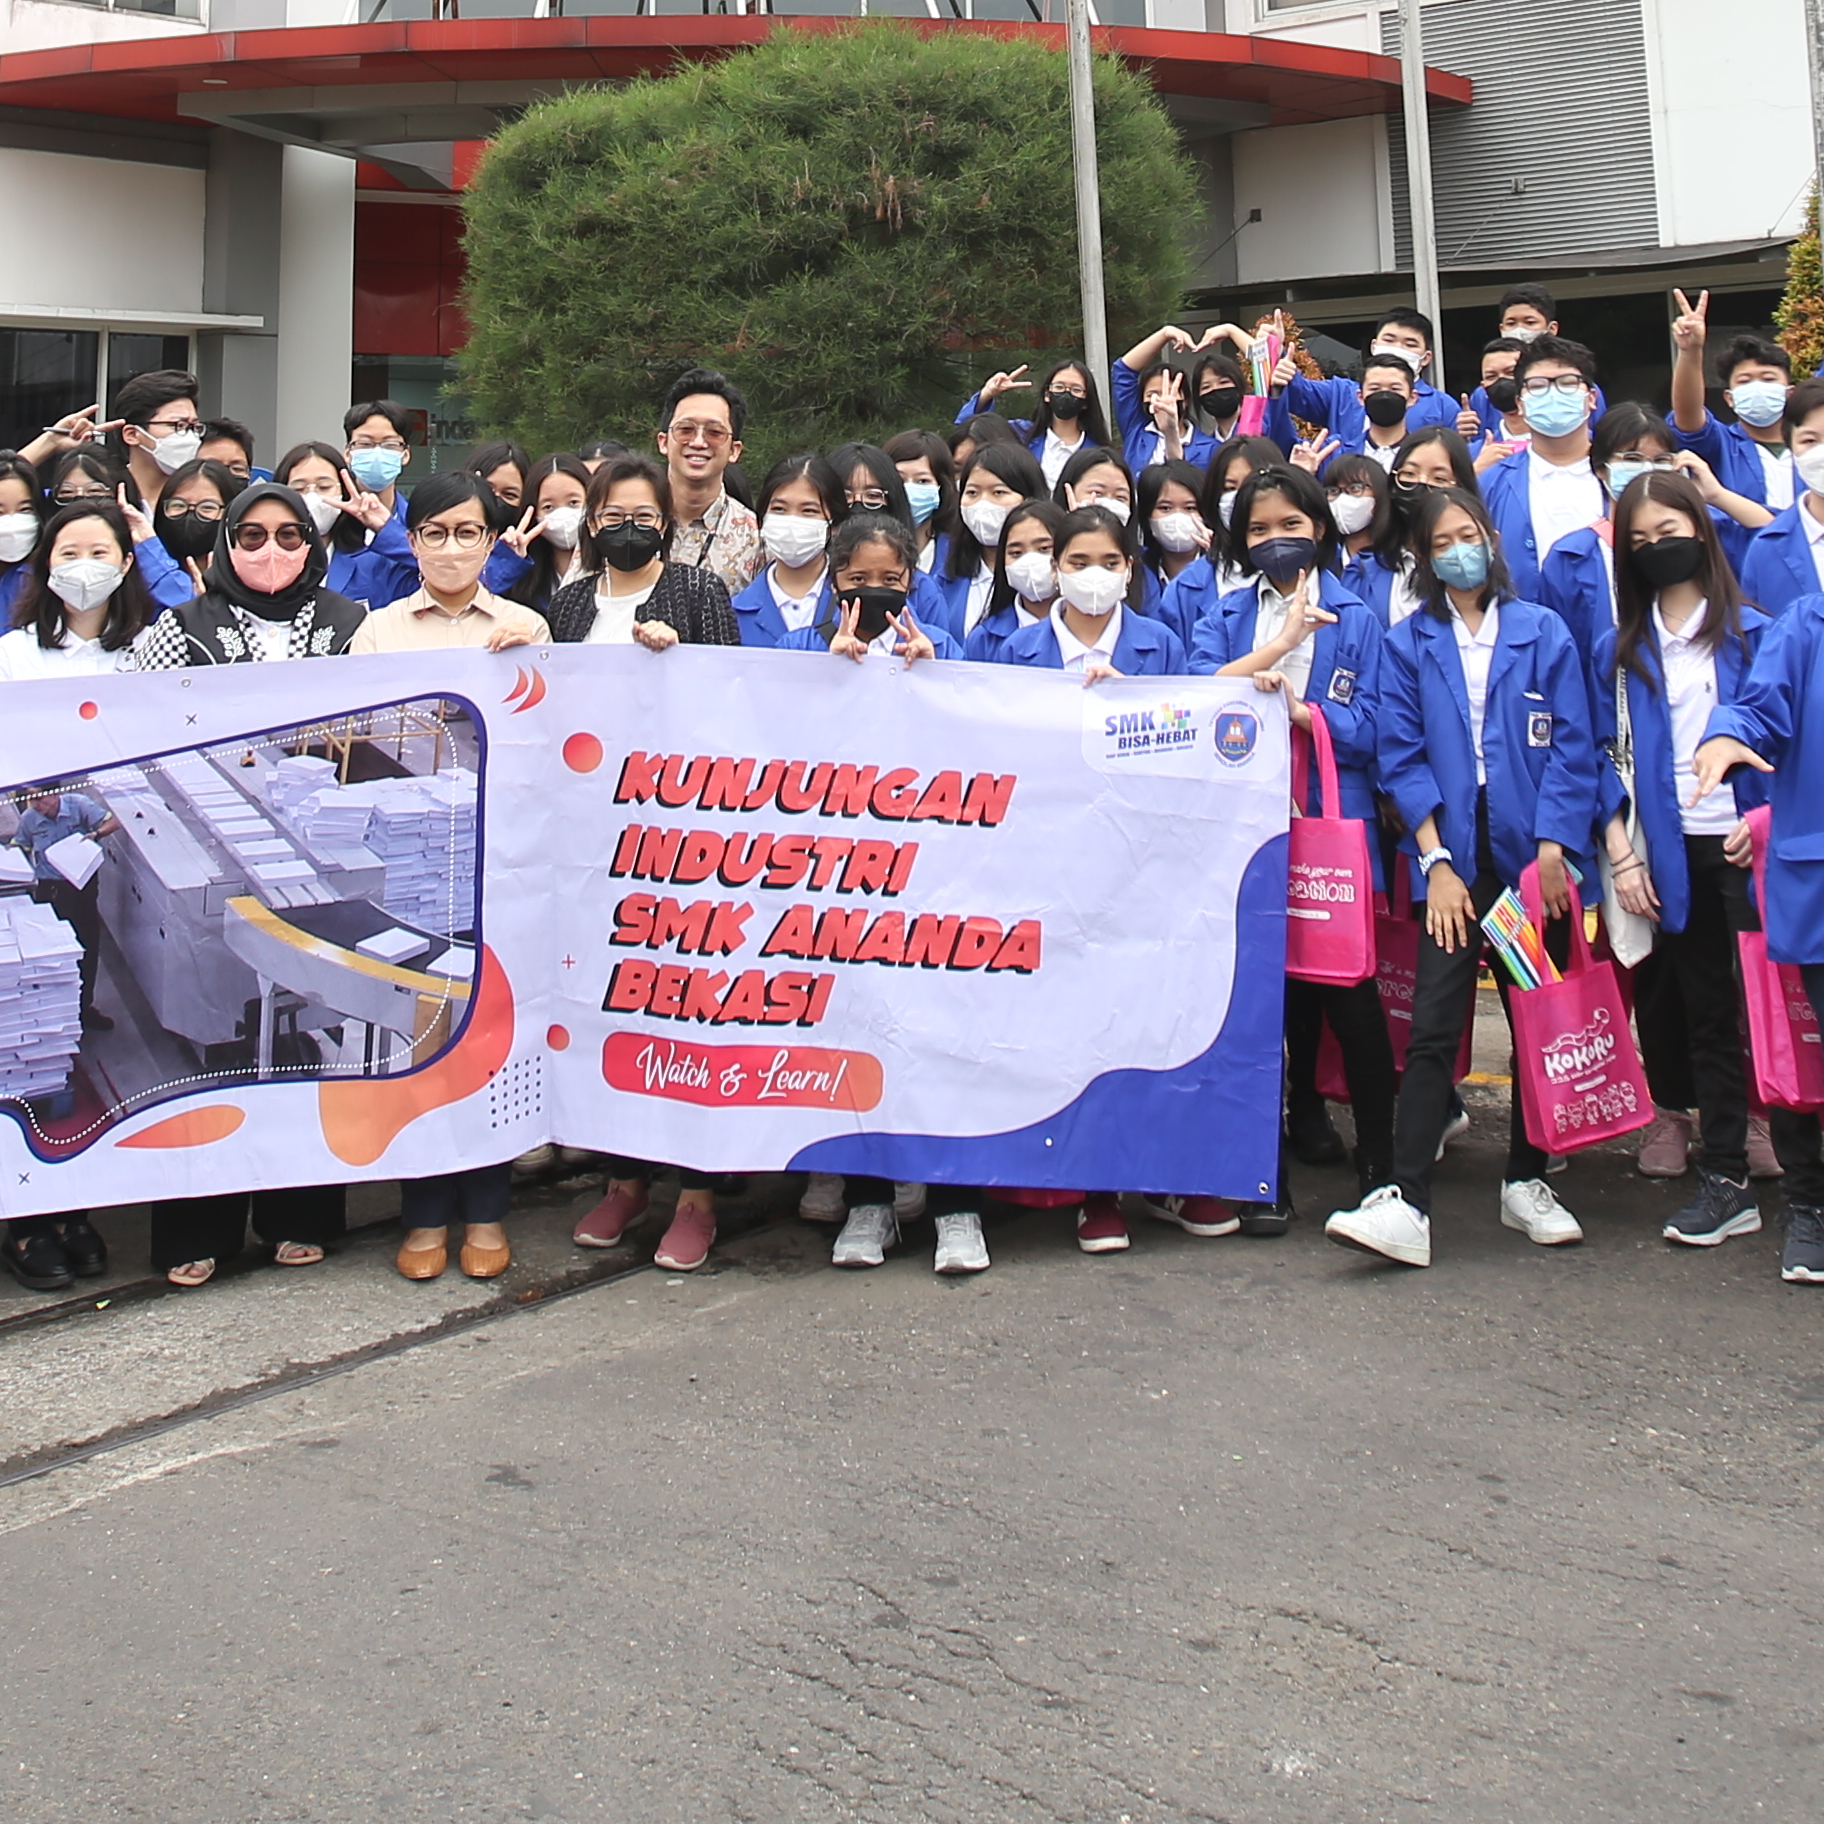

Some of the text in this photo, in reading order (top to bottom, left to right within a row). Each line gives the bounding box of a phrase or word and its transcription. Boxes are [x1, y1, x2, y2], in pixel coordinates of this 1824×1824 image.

[1105, 710, 1156, 736] SMK
[1118, 728, 1198, 750] BISA-HEBAT
[613, 750, 1017, 827] KUNJUNGAN
[609, 823, 919, 897] INDUSTRI
[609, 892, 1042, 975] SMK ANANDA
[601, 958, 836, 1027] BEKASI
[636, 1041, 847, 1102] Watch & Learn!
